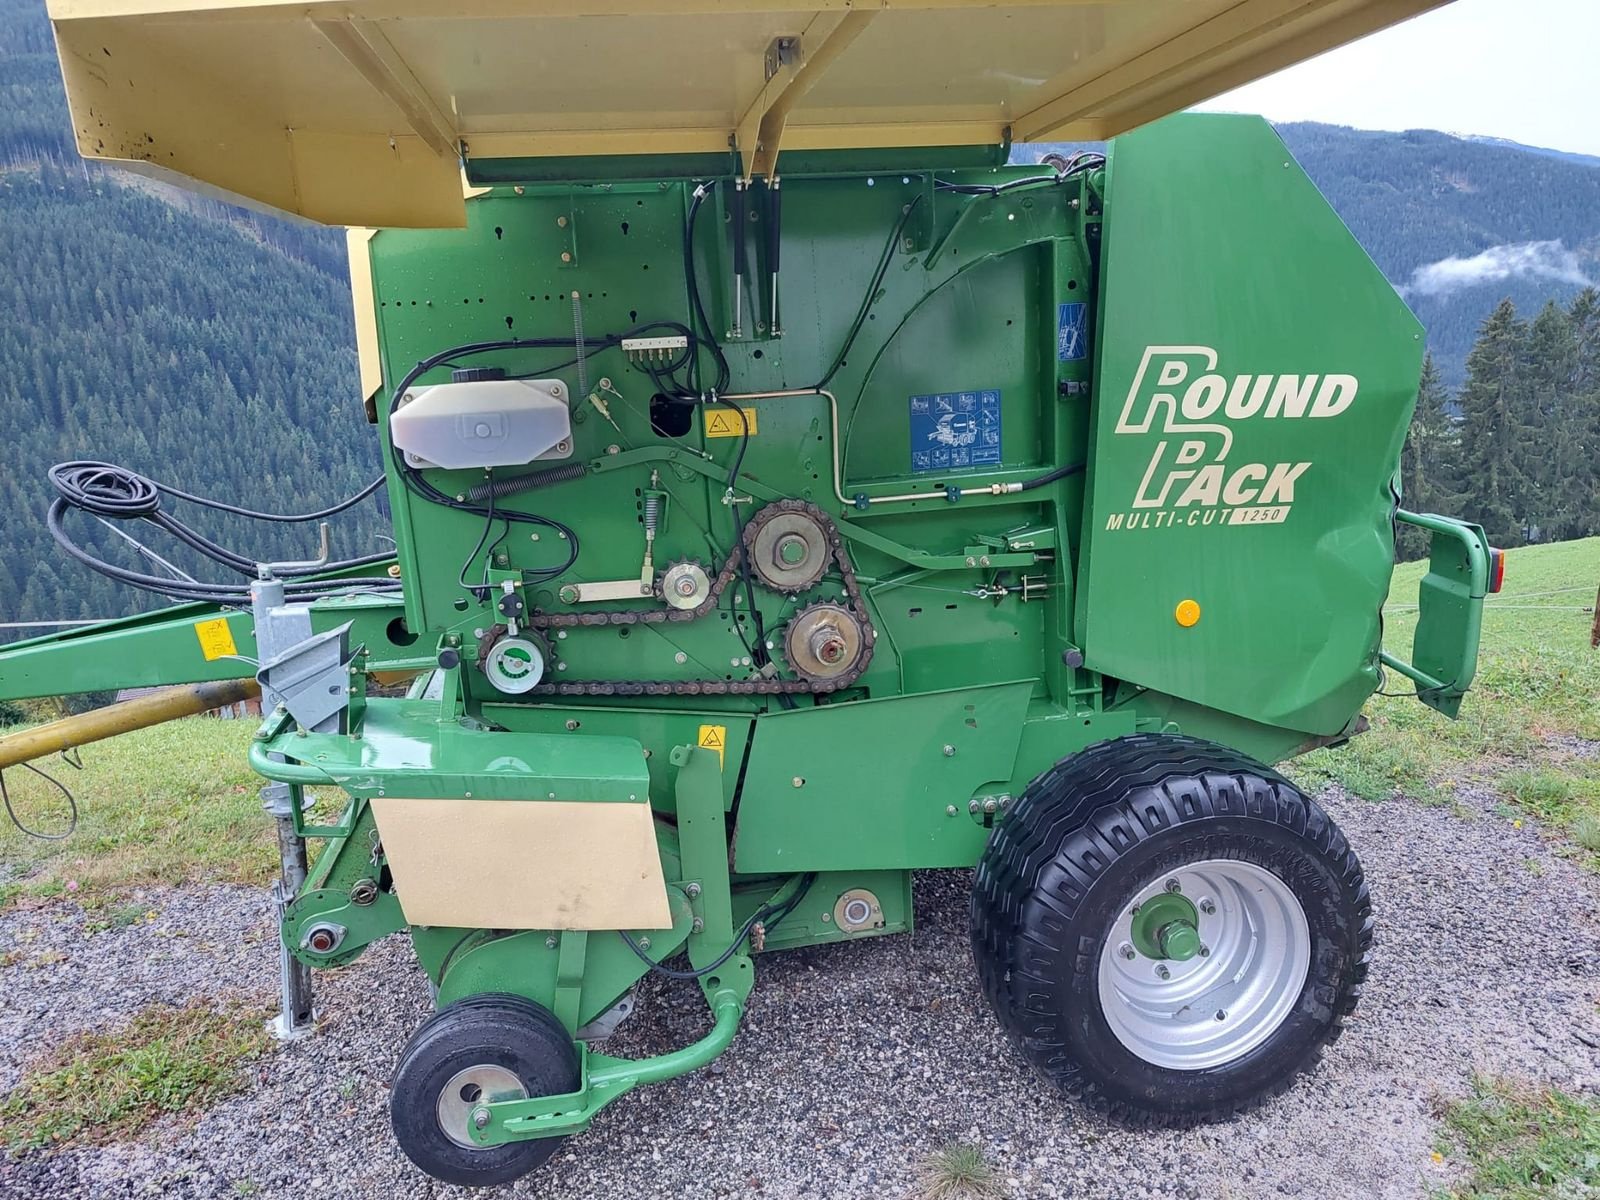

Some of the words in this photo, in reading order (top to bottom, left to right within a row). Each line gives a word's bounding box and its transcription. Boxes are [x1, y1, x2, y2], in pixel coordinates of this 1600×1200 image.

[1115, 345, 1358, 433] ROUND
[1132, 424, 1312, 508] PACK
[1105, 509, 1232, 530] MULTI-CUT
[1240, 509, 1281, 522] 1250
